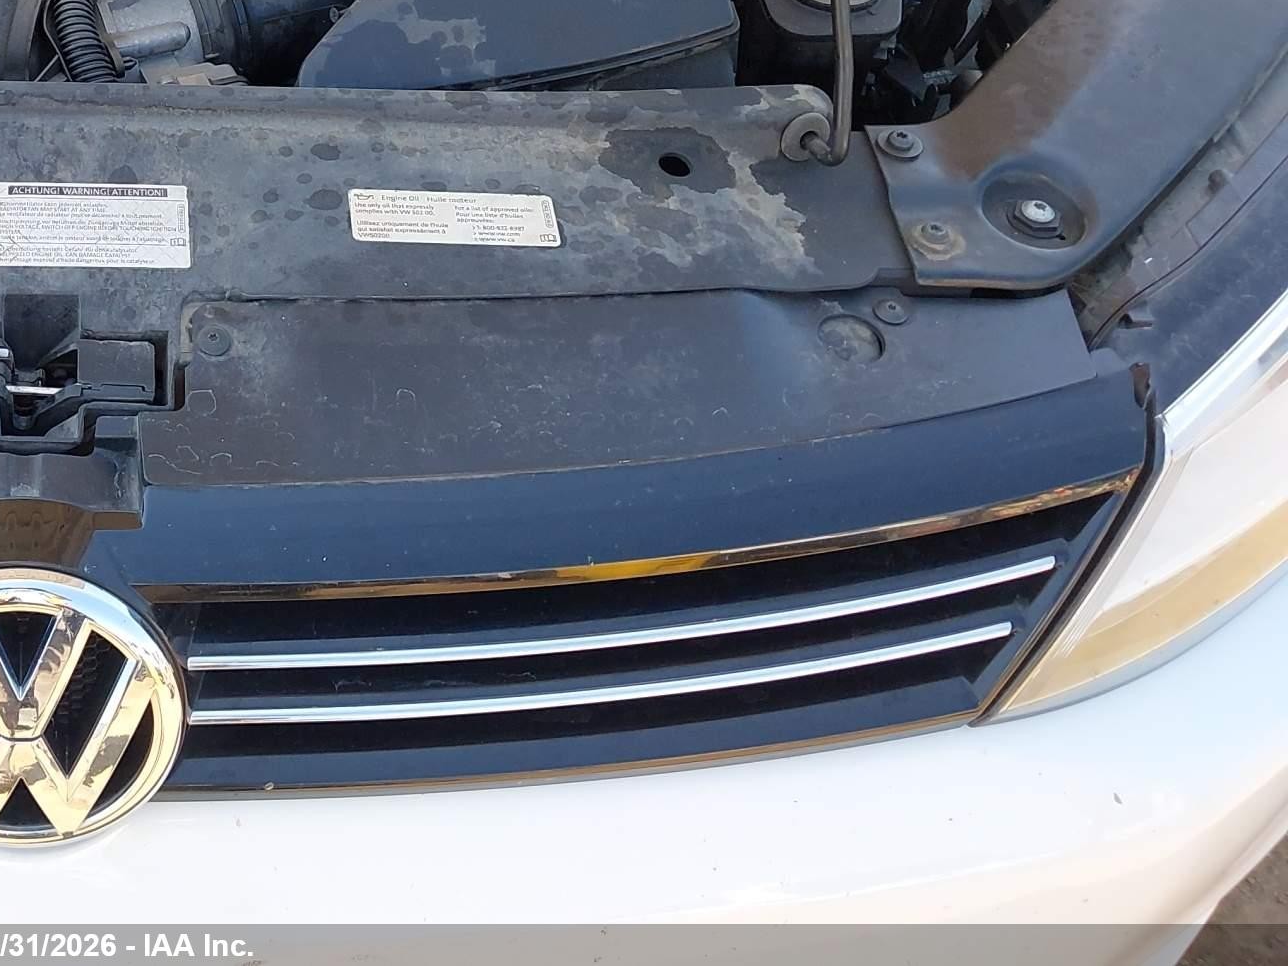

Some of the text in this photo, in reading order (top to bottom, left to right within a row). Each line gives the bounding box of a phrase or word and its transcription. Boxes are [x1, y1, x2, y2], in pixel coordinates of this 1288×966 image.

[12, 186, 165, 197] ACHTUNG! WARNING! ATTENTION!
[381, 194, 407, 203] Engine
